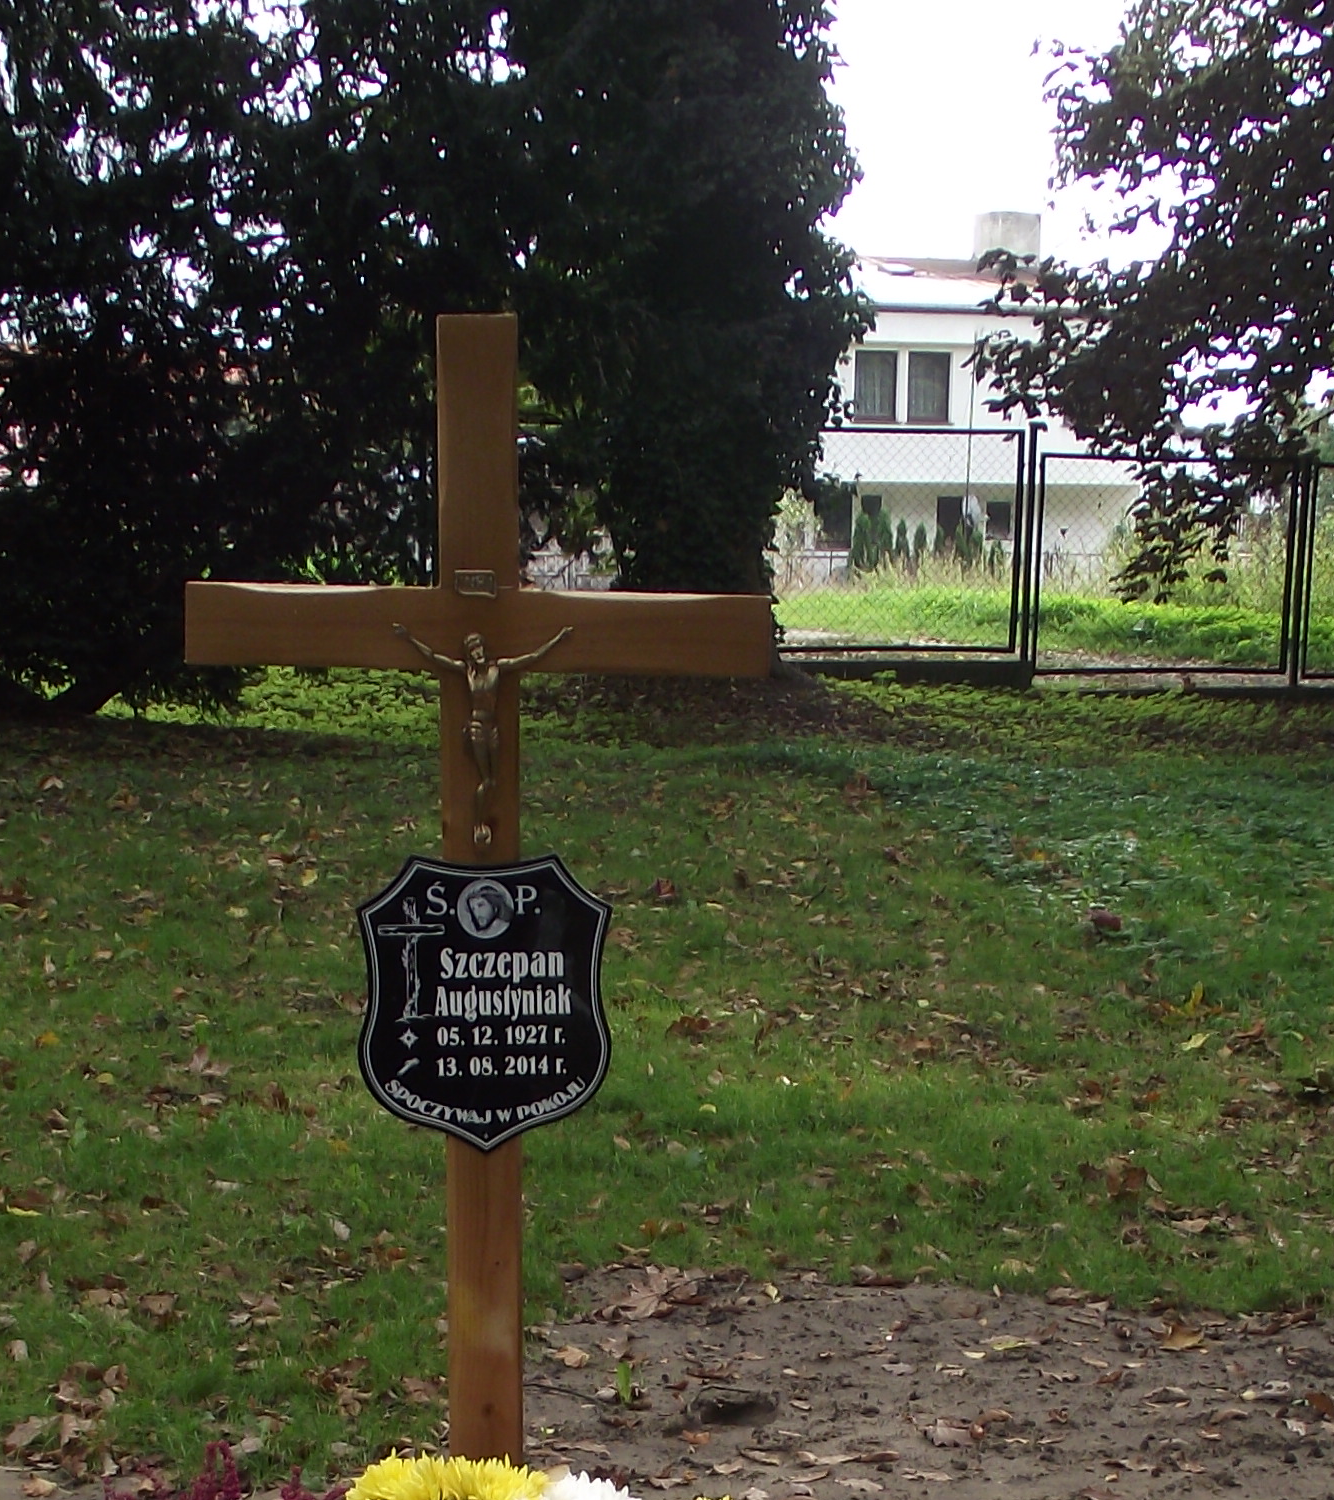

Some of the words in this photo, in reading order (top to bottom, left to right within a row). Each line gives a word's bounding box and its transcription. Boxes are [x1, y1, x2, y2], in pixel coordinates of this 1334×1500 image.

[440, 947, 564, 983] Szczepan
[434, 983, 572, 1022] Augustyniak
[505, 1024, 548, 1045] 1927
[504, 1054, 548, 1075] 2014
[384, 1079, 492, 1124] SPOCZYWAJ
[496, 1107, 513, 1123] W
[516, 1076, 587, 1121] POKOJU
